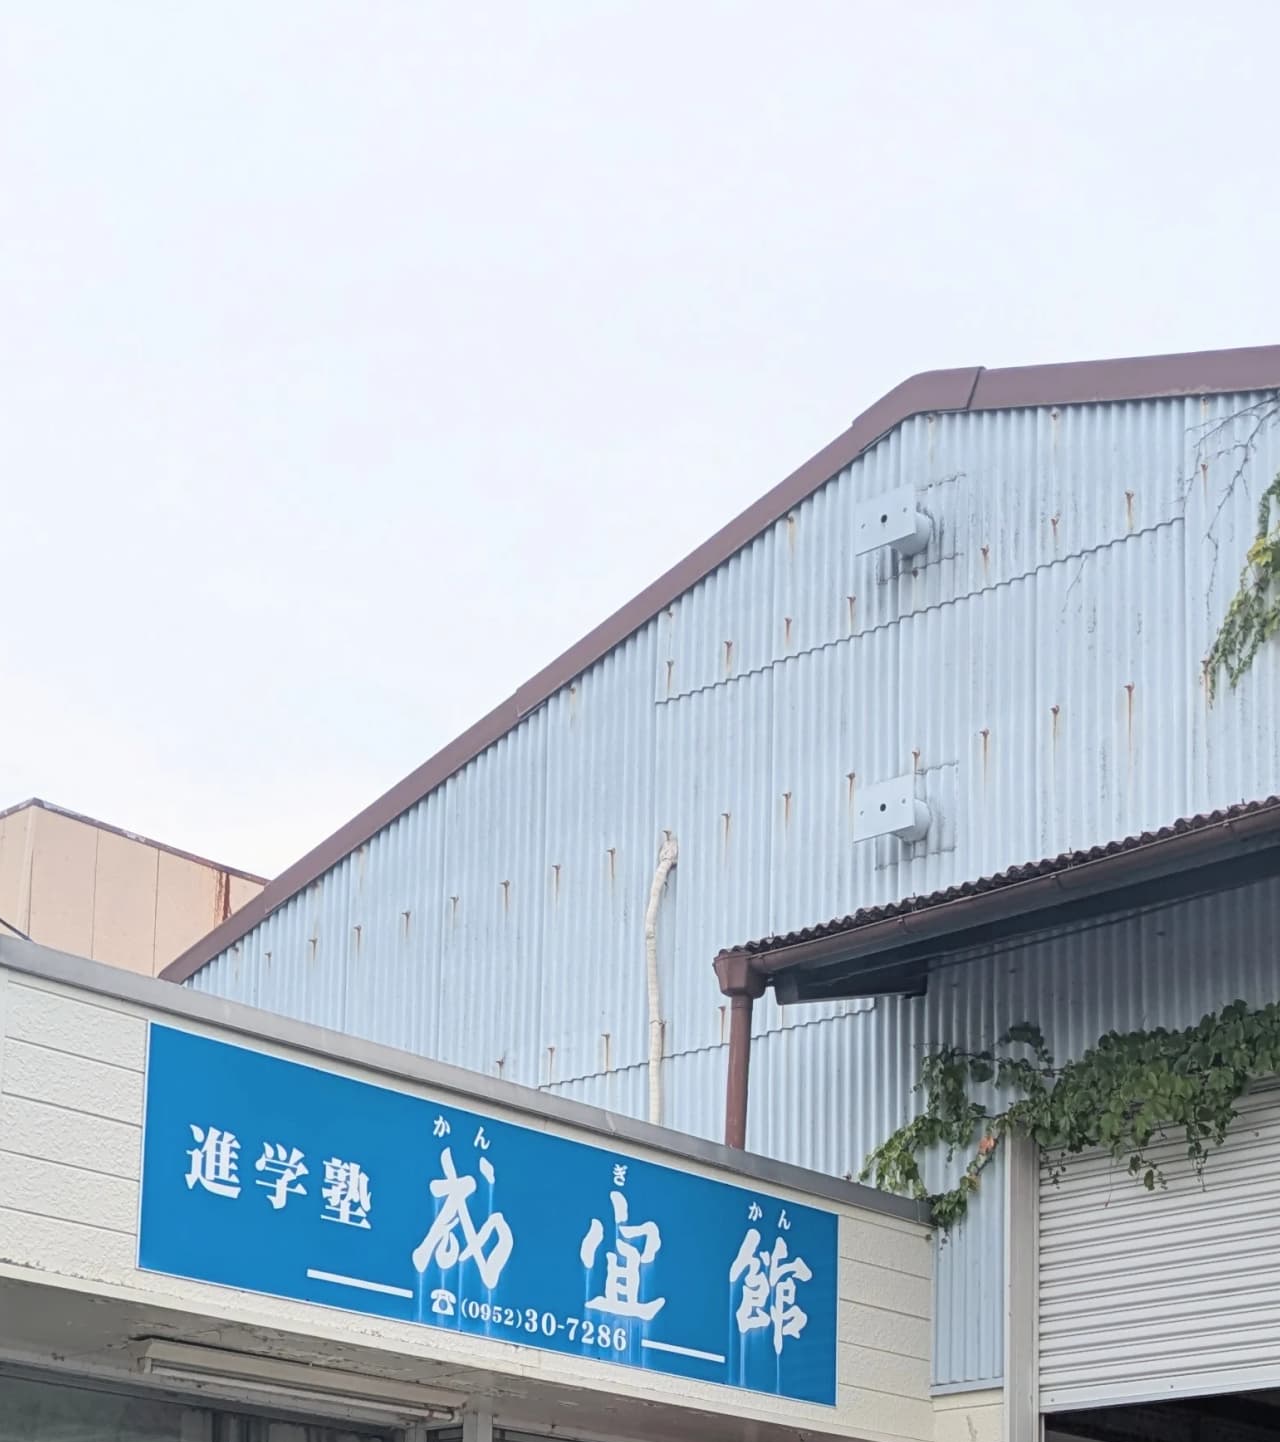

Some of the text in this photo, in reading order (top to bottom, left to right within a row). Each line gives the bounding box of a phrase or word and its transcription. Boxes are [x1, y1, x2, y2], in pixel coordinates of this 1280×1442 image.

[432, 1114, 491, 1150] かん
[183, 1123, 372, 1230] 進学塾
[611, 1162, 630, 1187] ぎ
[747, 1201, 792, 1230] かん
[460, 1297, 627, 1352] (0952)30-7286
